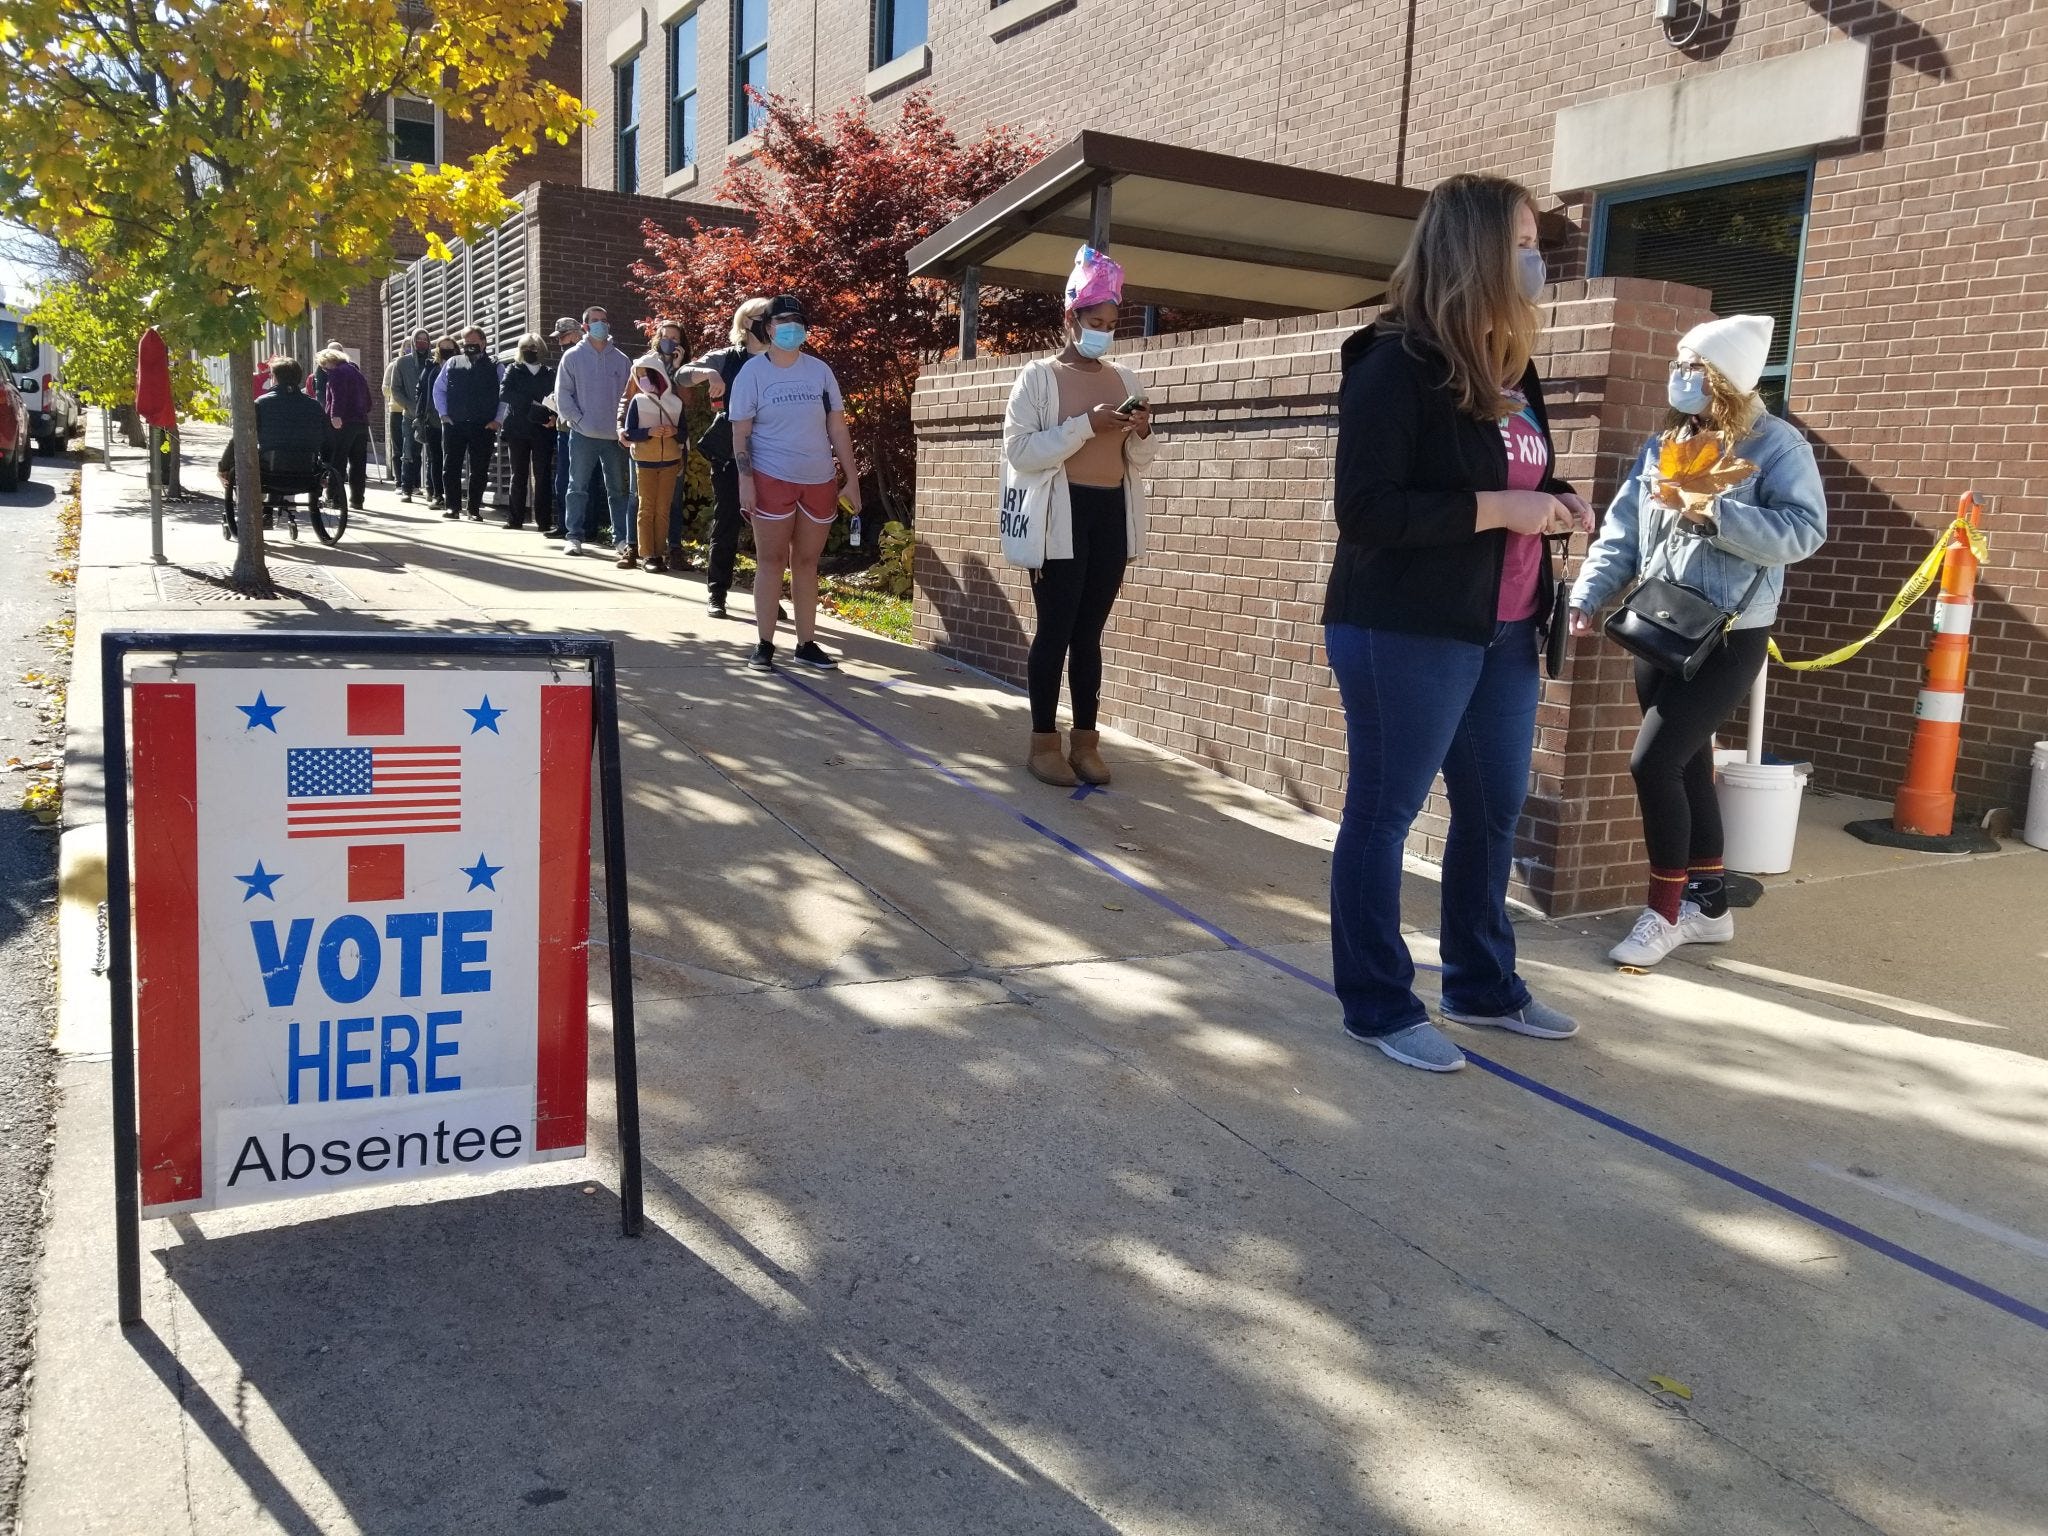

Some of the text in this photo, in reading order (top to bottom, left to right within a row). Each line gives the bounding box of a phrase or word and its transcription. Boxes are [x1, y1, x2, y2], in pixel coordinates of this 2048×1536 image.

[772, 393, 823, 404] nutrition
[1516, 434, 1547, 465] KIN
[250, 909, 493, 1008] VOTE
[287, 1010, 462, 1105] HERE
[226, 1119, 522, 1187] Absentee
